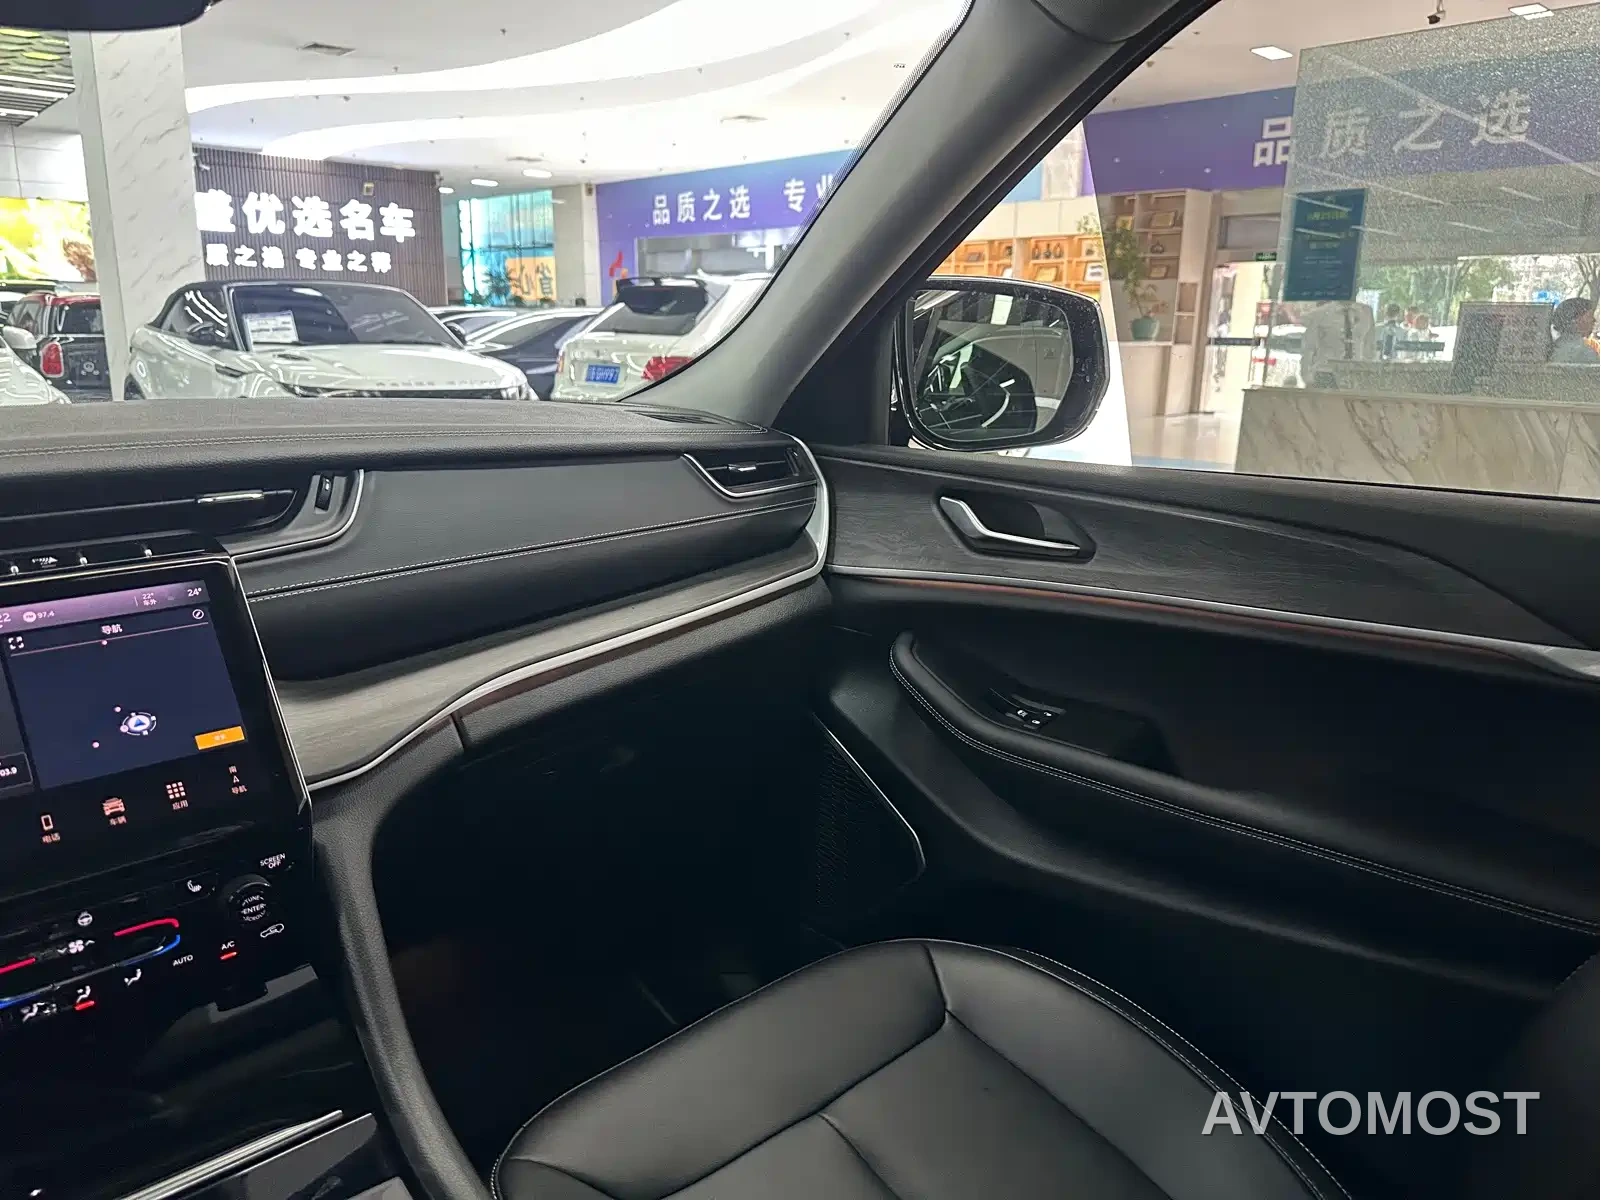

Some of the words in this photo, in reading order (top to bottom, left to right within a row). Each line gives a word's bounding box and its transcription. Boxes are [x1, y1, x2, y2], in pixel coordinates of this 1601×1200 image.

[652, 184, 751, 226] 品质之选
[187, 587, 203, 598] 24°
[37, 609, 55, 620] 97.4
[101, 623, 123, 636] 导航
[259, 852, 286, 867] SCREEN
[268, 860, 282, 869] OFF
[243, 903, 265, 915] ENTER
[221, 940, 236, 951] A/C
[173, 954, 194, 967] AUTO
